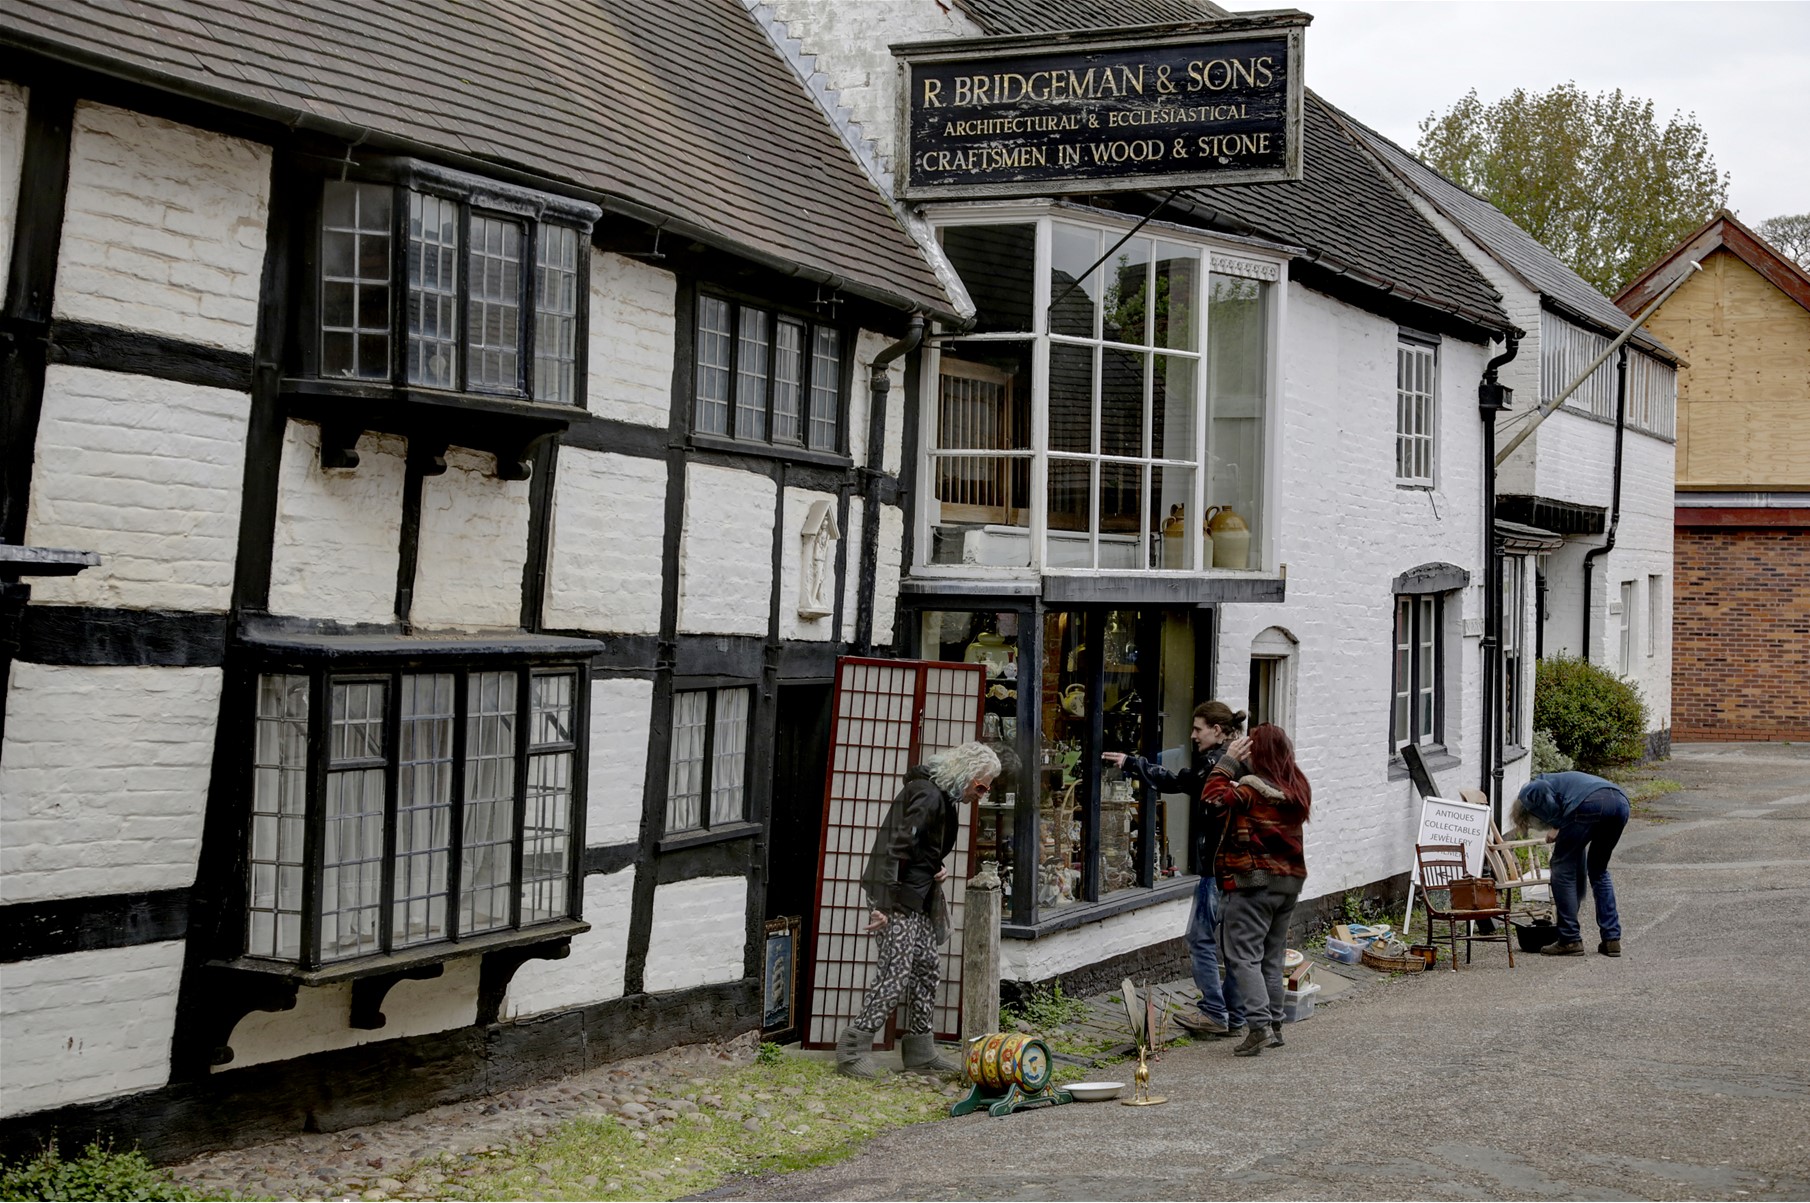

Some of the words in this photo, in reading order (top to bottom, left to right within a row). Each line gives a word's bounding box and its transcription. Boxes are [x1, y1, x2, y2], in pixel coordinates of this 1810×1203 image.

[954, 64, 1144, 106] BRIDGEMAN
[1156, 63, 1179, 95] &
[1187, 56, 1274, 92] SONS
[942, 113, 1080, 137] ARCHITECTURAL
[1088, 112, 1101, 129] &
[1109, 103, 1251, 128] ECCLESIASTICAL
[921, 145, 1047, 171] CRAFTSMEN
[1058, 143, 1081, 165] IN
[1090, 138, 1166, 163] WOOD
[1172, 137, 1190, 159] &
[1198, 132, 1273, 157] STONE
[1424, 819, 1481, 836] COLLECTABLES
[1435, 809, 1475, 822] ANTIQUES
